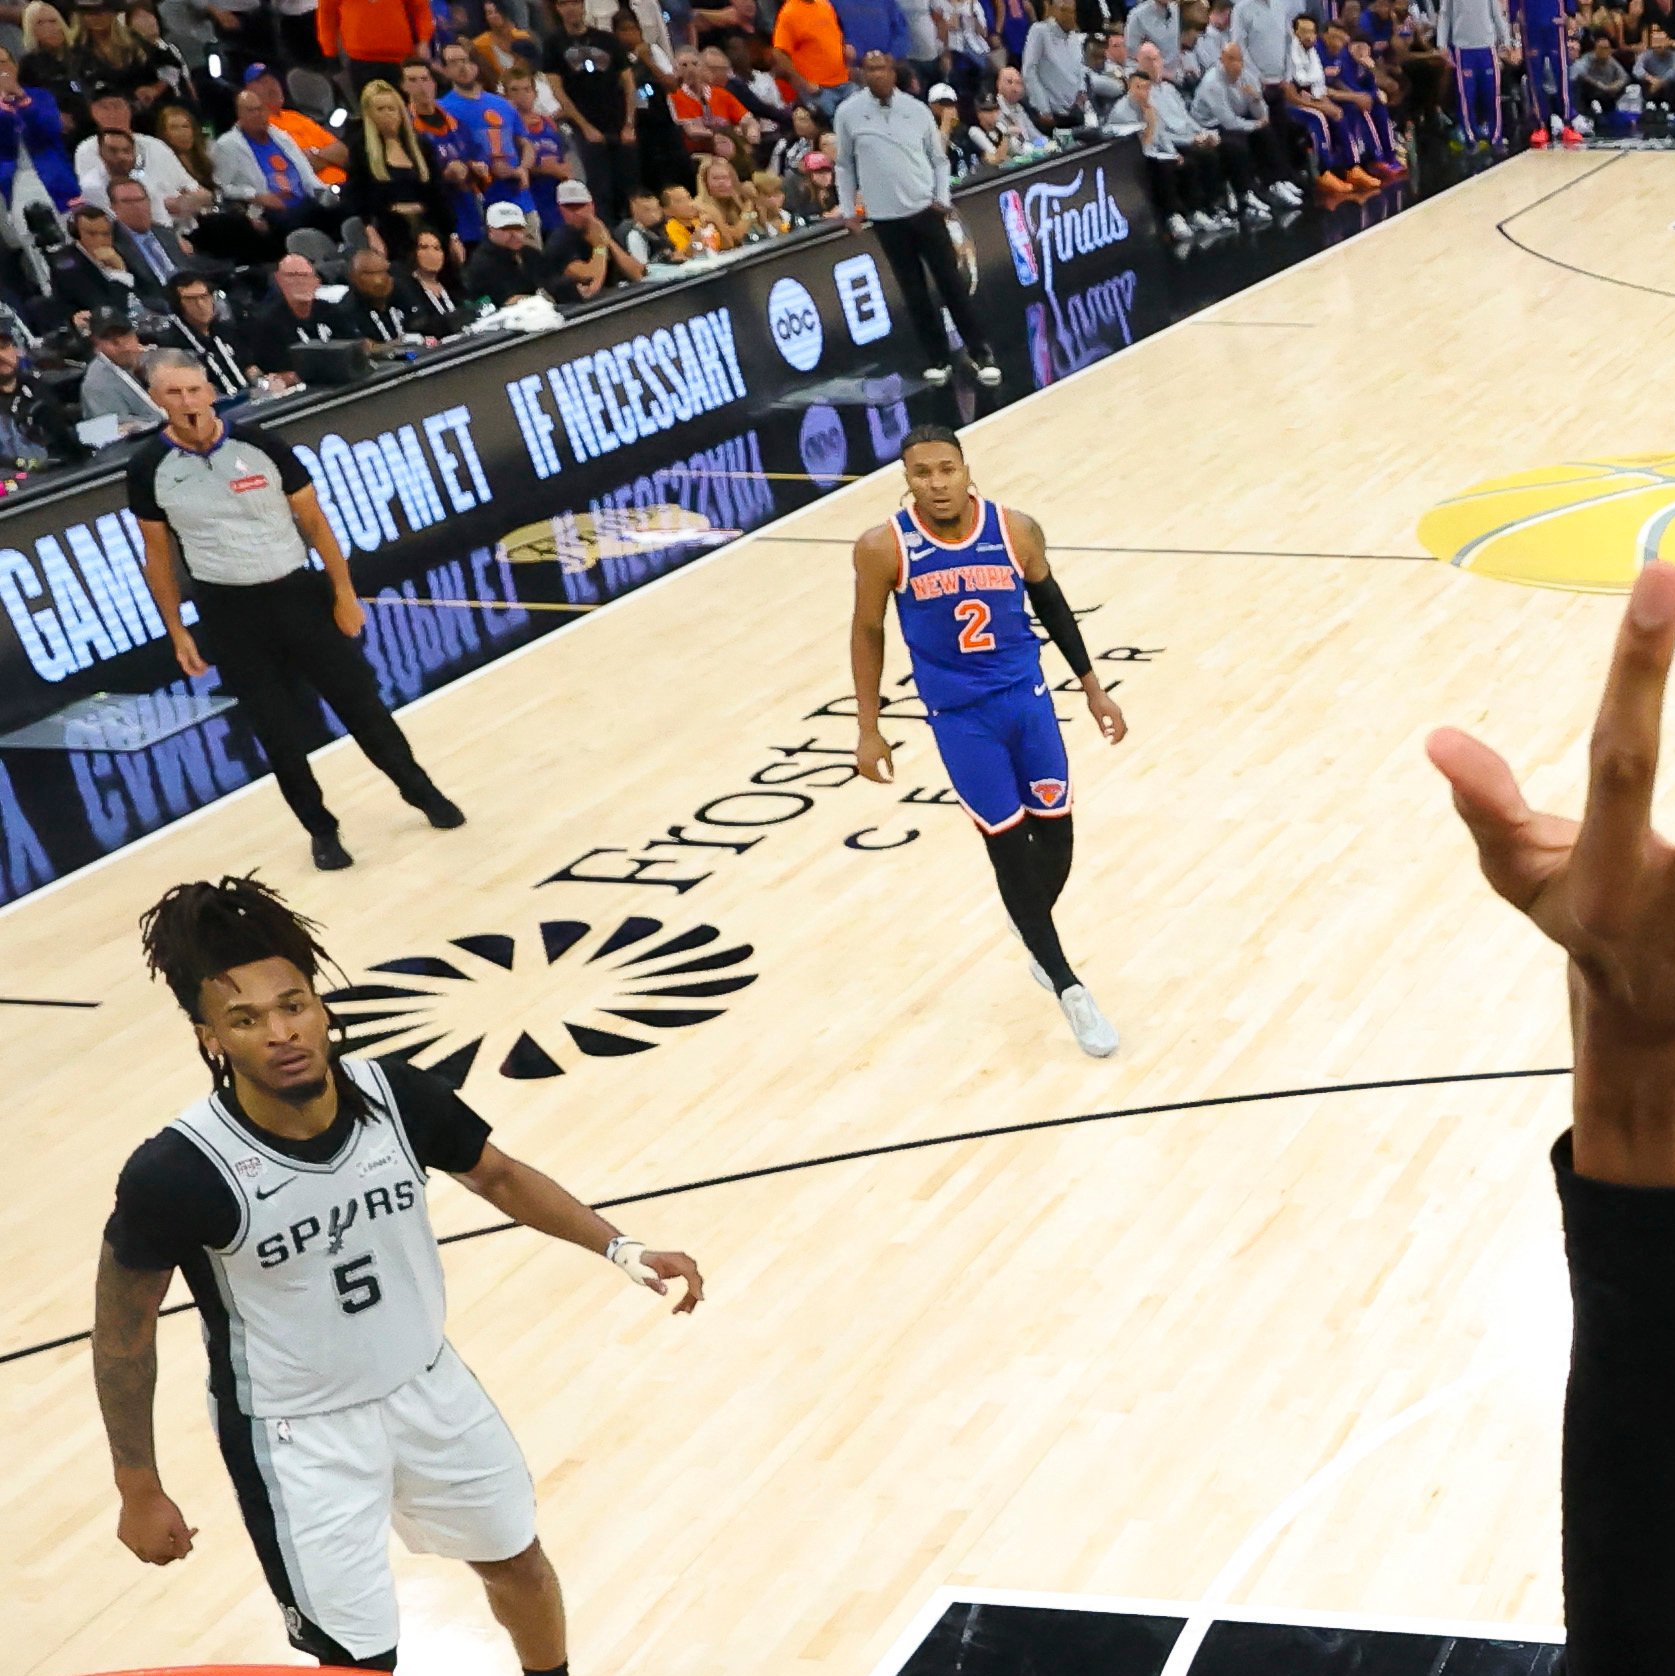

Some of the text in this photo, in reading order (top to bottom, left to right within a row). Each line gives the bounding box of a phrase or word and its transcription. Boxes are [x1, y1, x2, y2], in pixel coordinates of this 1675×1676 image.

[1024, 166, 1129, 292] Finals
[776, 303, 815, 342] abc
[0, 508, 200, 683] GAM
[422, 404, 493, 513] ET
[506, 373, 562, 480] IF
[546, 306, 748, 464] NECESSARY
[910, 564, 1016, 601] NEW YORK
[953, 598, 997, 654] 2
[256, 1179, 416, 1270] SPURS
[332, 1249, 383, 1317] 5
